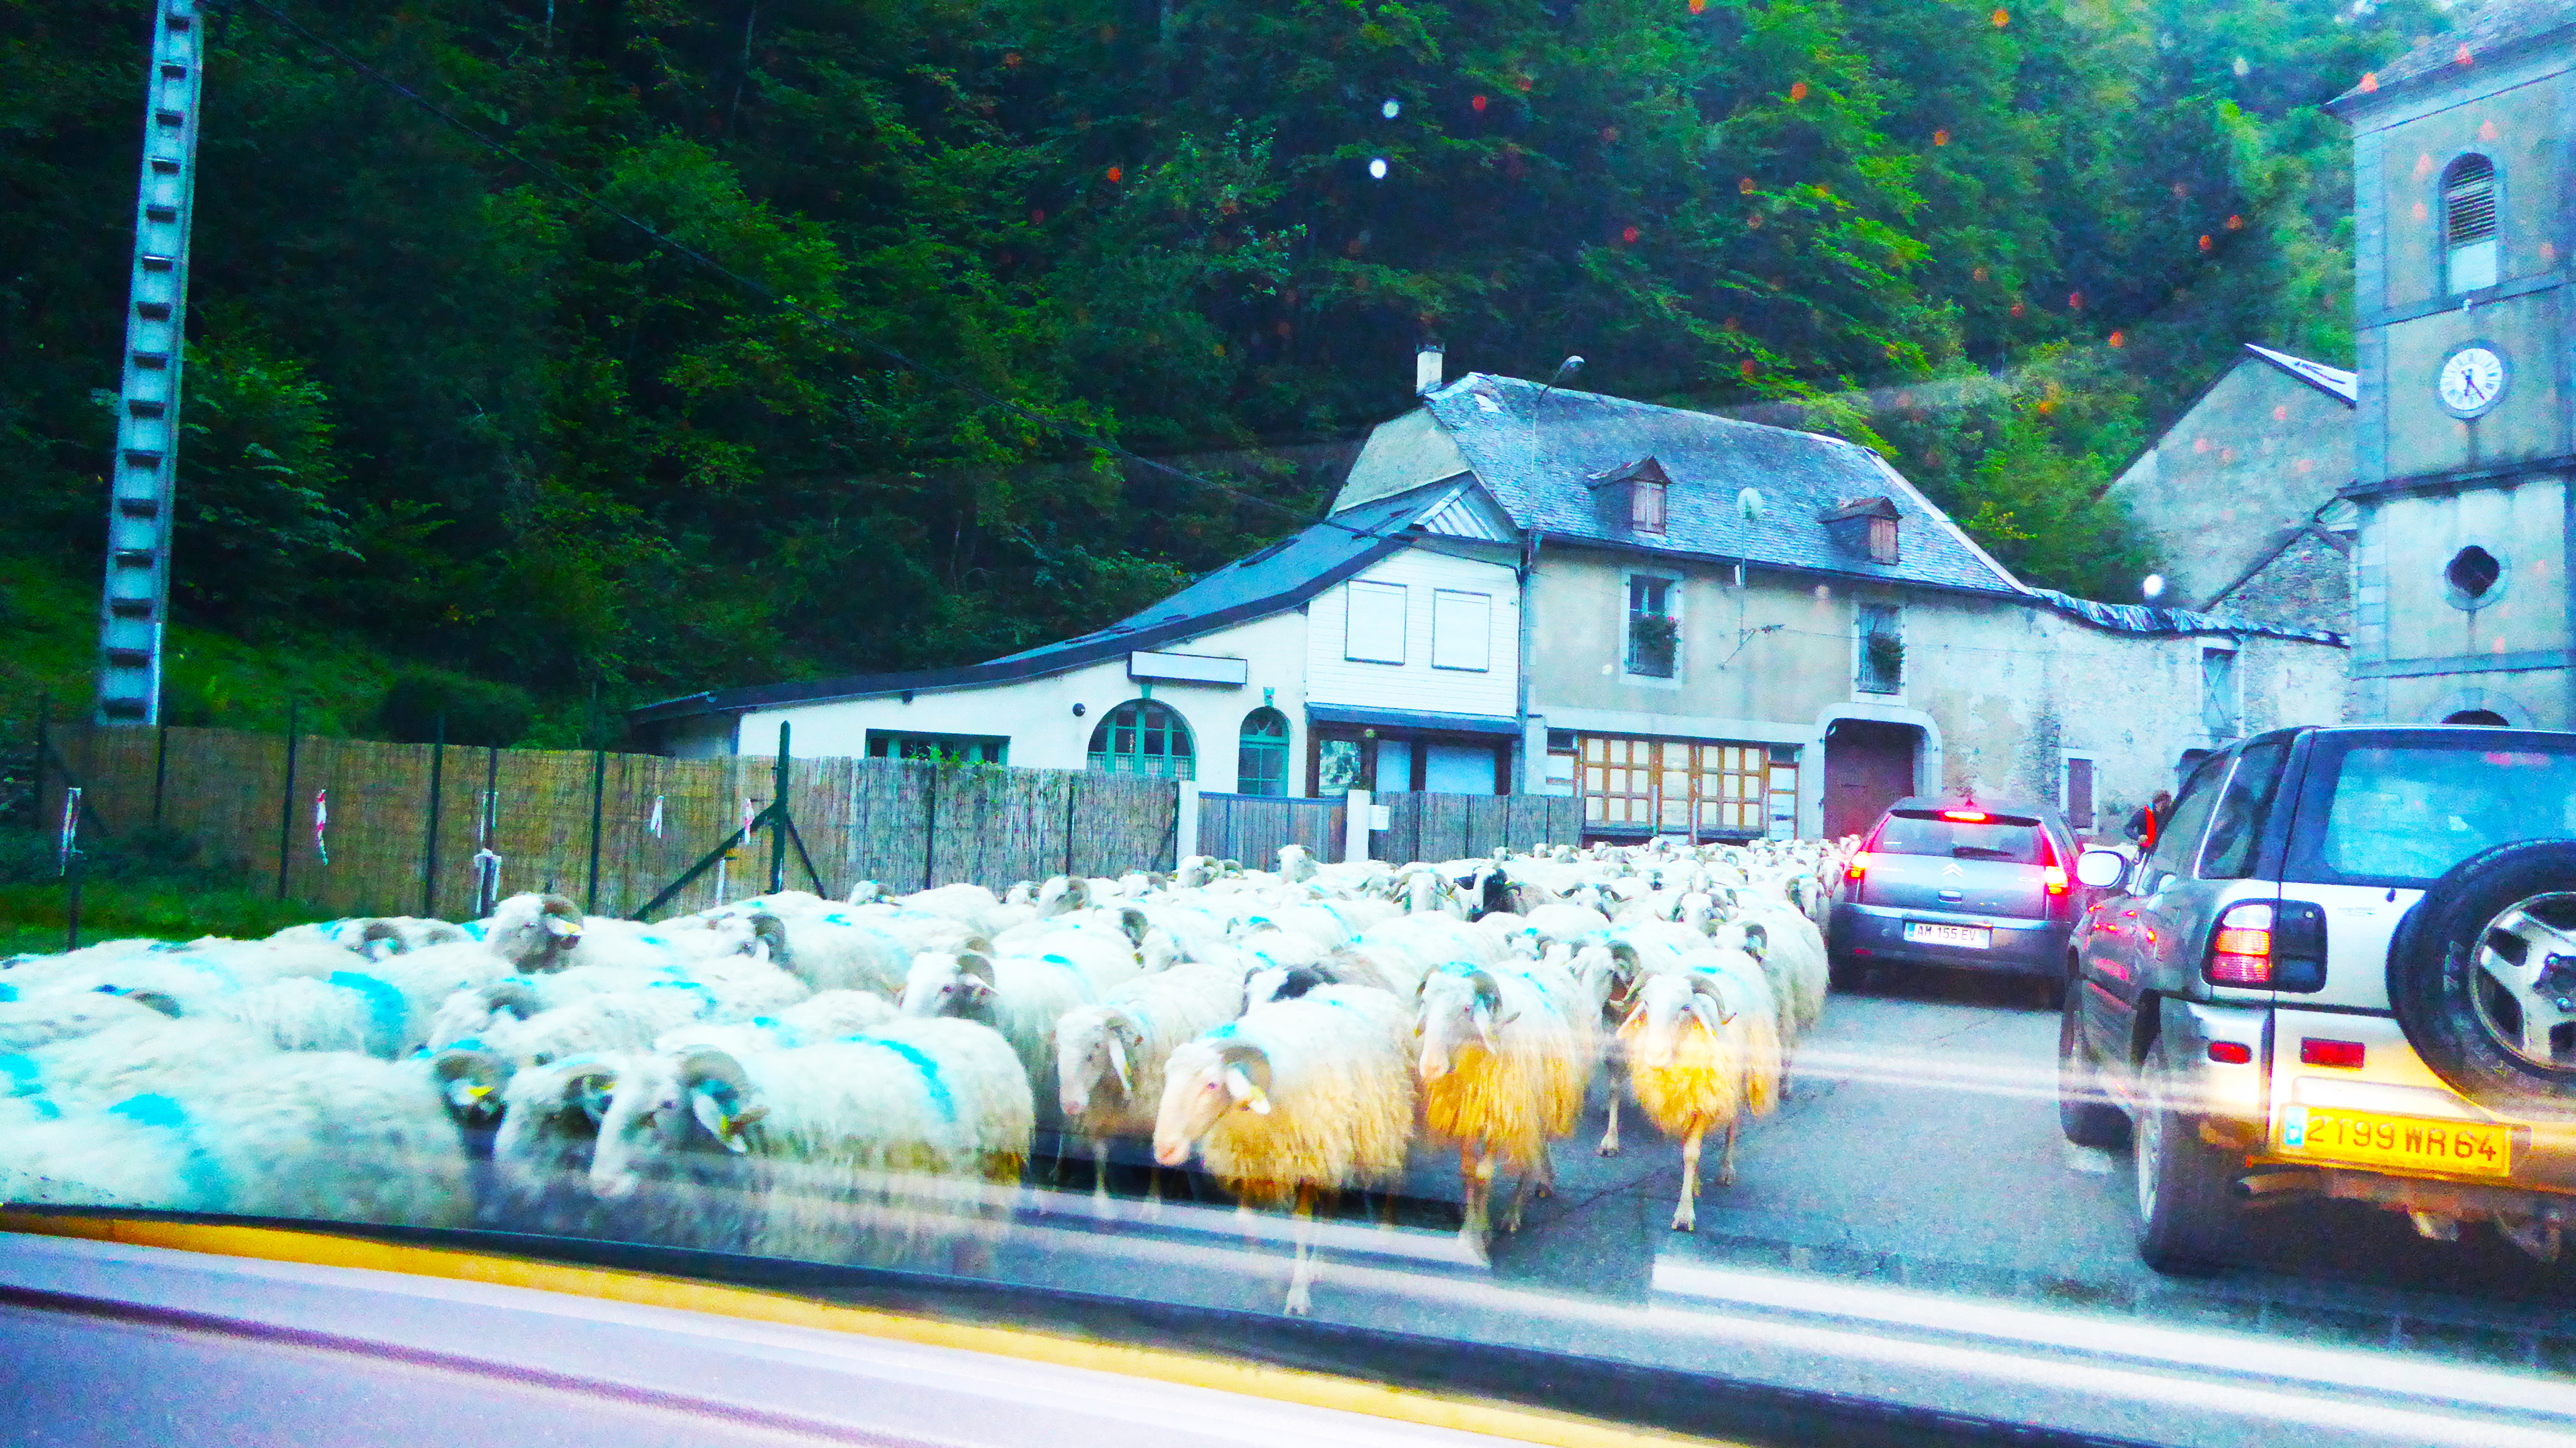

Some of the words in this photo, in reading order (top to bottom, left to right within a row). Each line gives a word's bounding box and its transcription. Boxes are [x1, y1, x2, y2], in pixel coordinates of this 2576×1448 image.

[1937, 927, 1957, 939] 155
[1961, 929, 1976, 941] EV
[2307, 1114, 2394, 1150] 2199
[2406, 1124, 2446, 1156] WR
[2454, 1129, 2496, 1161] 64
